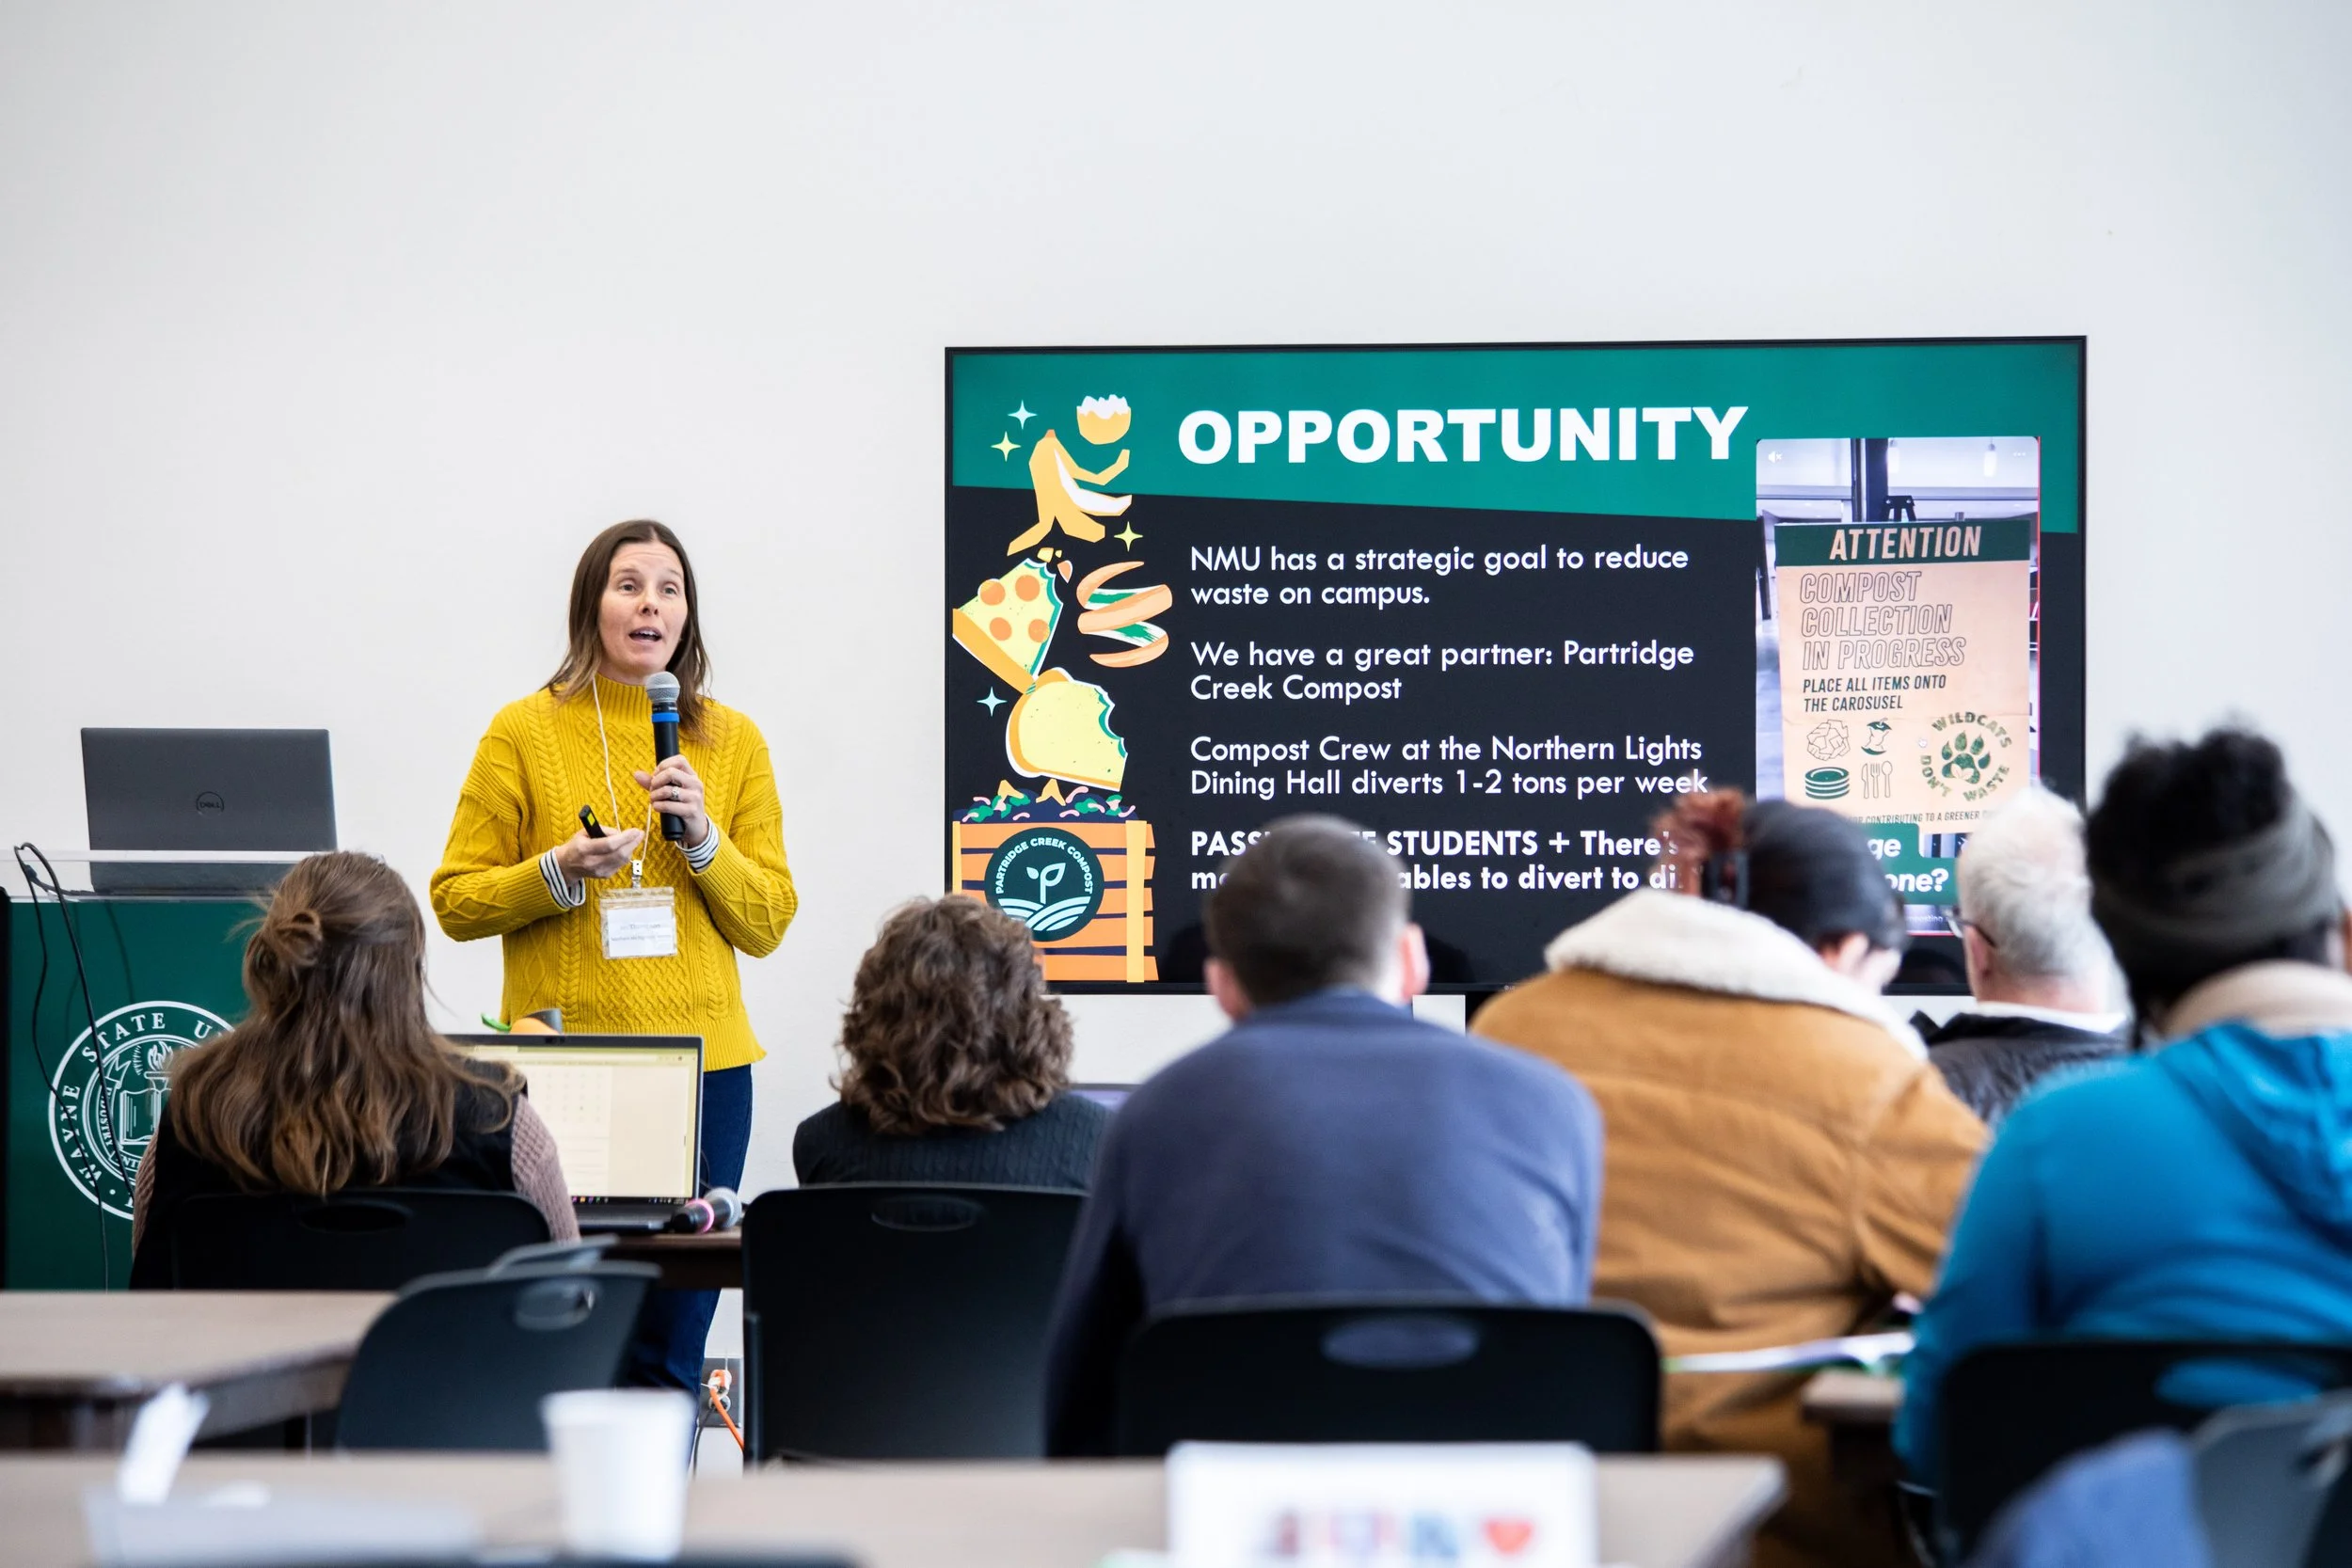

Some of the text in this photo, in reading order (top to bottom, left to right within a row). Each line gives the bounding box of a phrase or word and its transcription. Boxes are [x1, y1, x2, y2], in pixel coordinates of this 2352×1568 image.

[1179, 405, 1749, 464] OPPORTUNITY
[1191, 543, 1689, 576] NMU has a strategic goal to reduce
[1829, 526, 1981, 561] ATTENTION
[1191, 584, 1430, 610] waste on campus.
[1800, 571, 1922, 604] COMPOST
[1802, 604, 1953, 637] COLLECTION
[1191, 640, 1694, 673] We have a great partner: Partridge
[1803, 637, 1967, 670] IN PROGRESS
[1191, 675, 1403, 705] Creek Compost
[1803, 673, 1947, 693] PLACE ALL ITEMS ONTO
[1804, 695, 1903, 712] THE CAROSUSEL
[1931, 711, 2012, 749] WILDCATS
[1191, 734, 1702, 767] Compost Crew at the Northern Lights
[1191, 768, 1708, 800] Dining Hall diverts 1-2 tons per week
[1920, 755, 2010, 801] DON'T WASTE
[1926, 813, 1935, 822] TO
[1937, 812, 1943, 821] A
[1945, 811, 1979, 821] GREENER
[1387, 831, 1537, 856] STUDENTS
[1548, 832, 1569, 854] +
[995, 837, 1093, 895] PARTRIDGE CREEK COMPOST
[1481, 866, 1509, 889] to
[1518, 863, 1603, 889] divert
[1612, 866, 1639, 889] to
[82, 1012, 166, 1063] STATE
